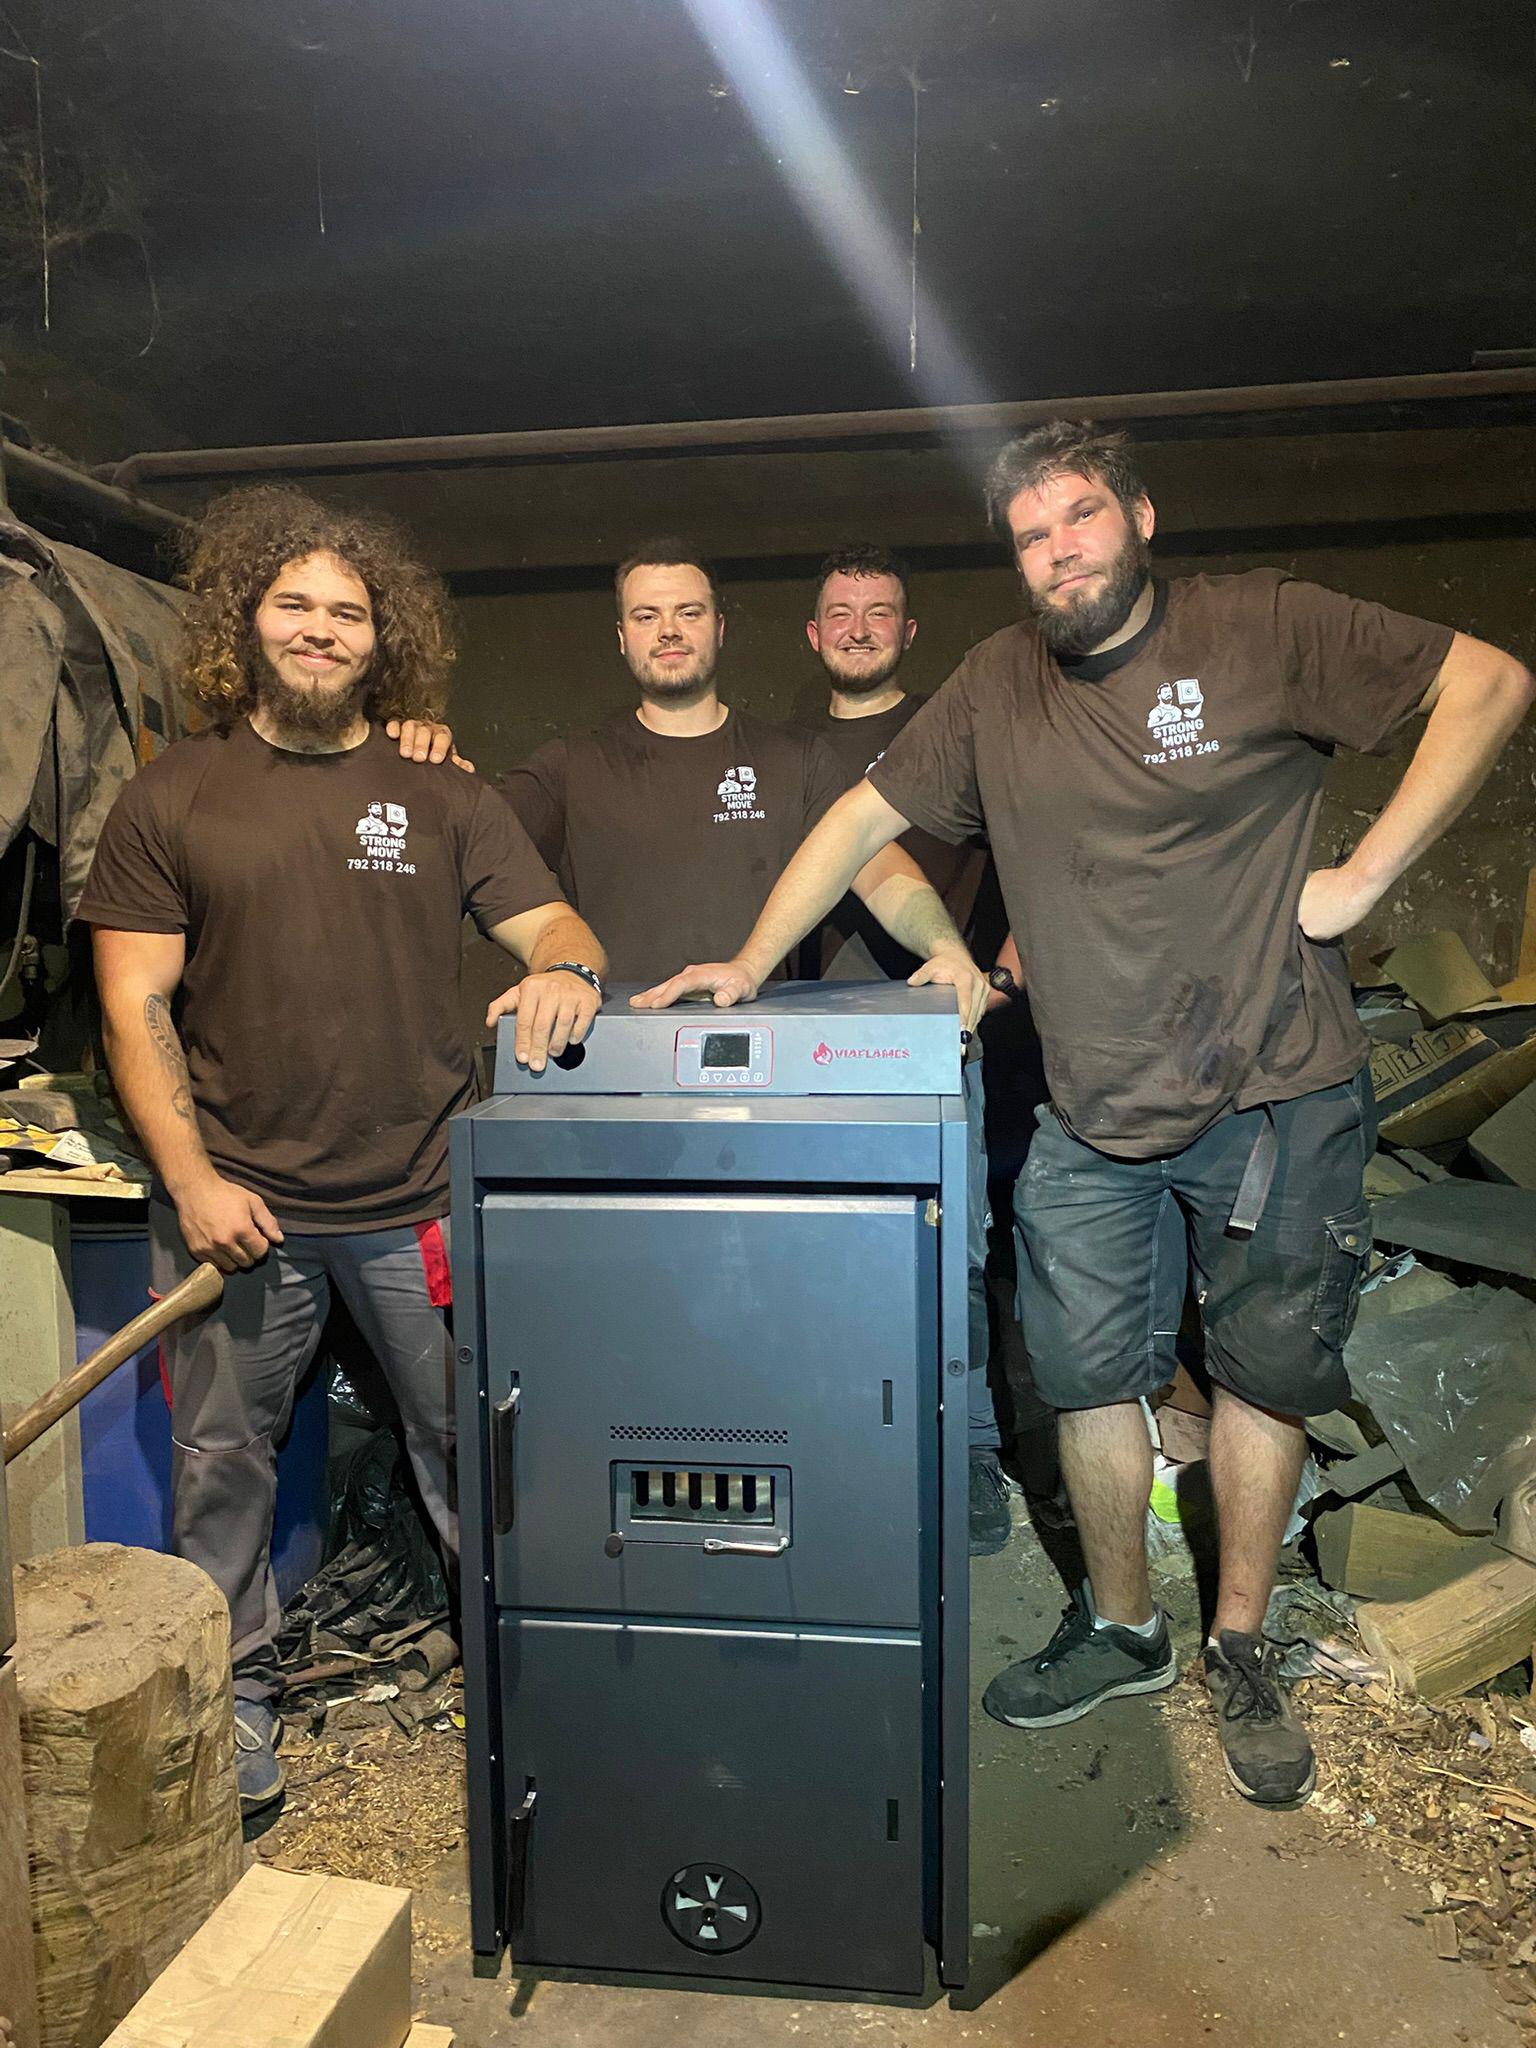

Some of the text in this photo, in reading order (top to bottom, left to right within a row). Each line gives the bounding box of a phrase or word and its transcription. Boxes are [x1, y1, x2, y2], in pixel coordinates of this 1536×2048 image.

[1153, 719, 1204, 739] STRONG
[1162, 731, 1199, 748] MOVE
[1143, 740, 1219, 764] 792 318 246
[721, 792, 756, 803] STRONG
[727, 801, 753, 810] MOVE
[713, 810, 766, 823] 792 318 246
[360, 835, 406, 850] STRONG
[367, 846, 401, 860] MOVE
[347, 859, 416, 875] 792 318 246
[834, 1048, 910, 1059] VIAFLAMES
